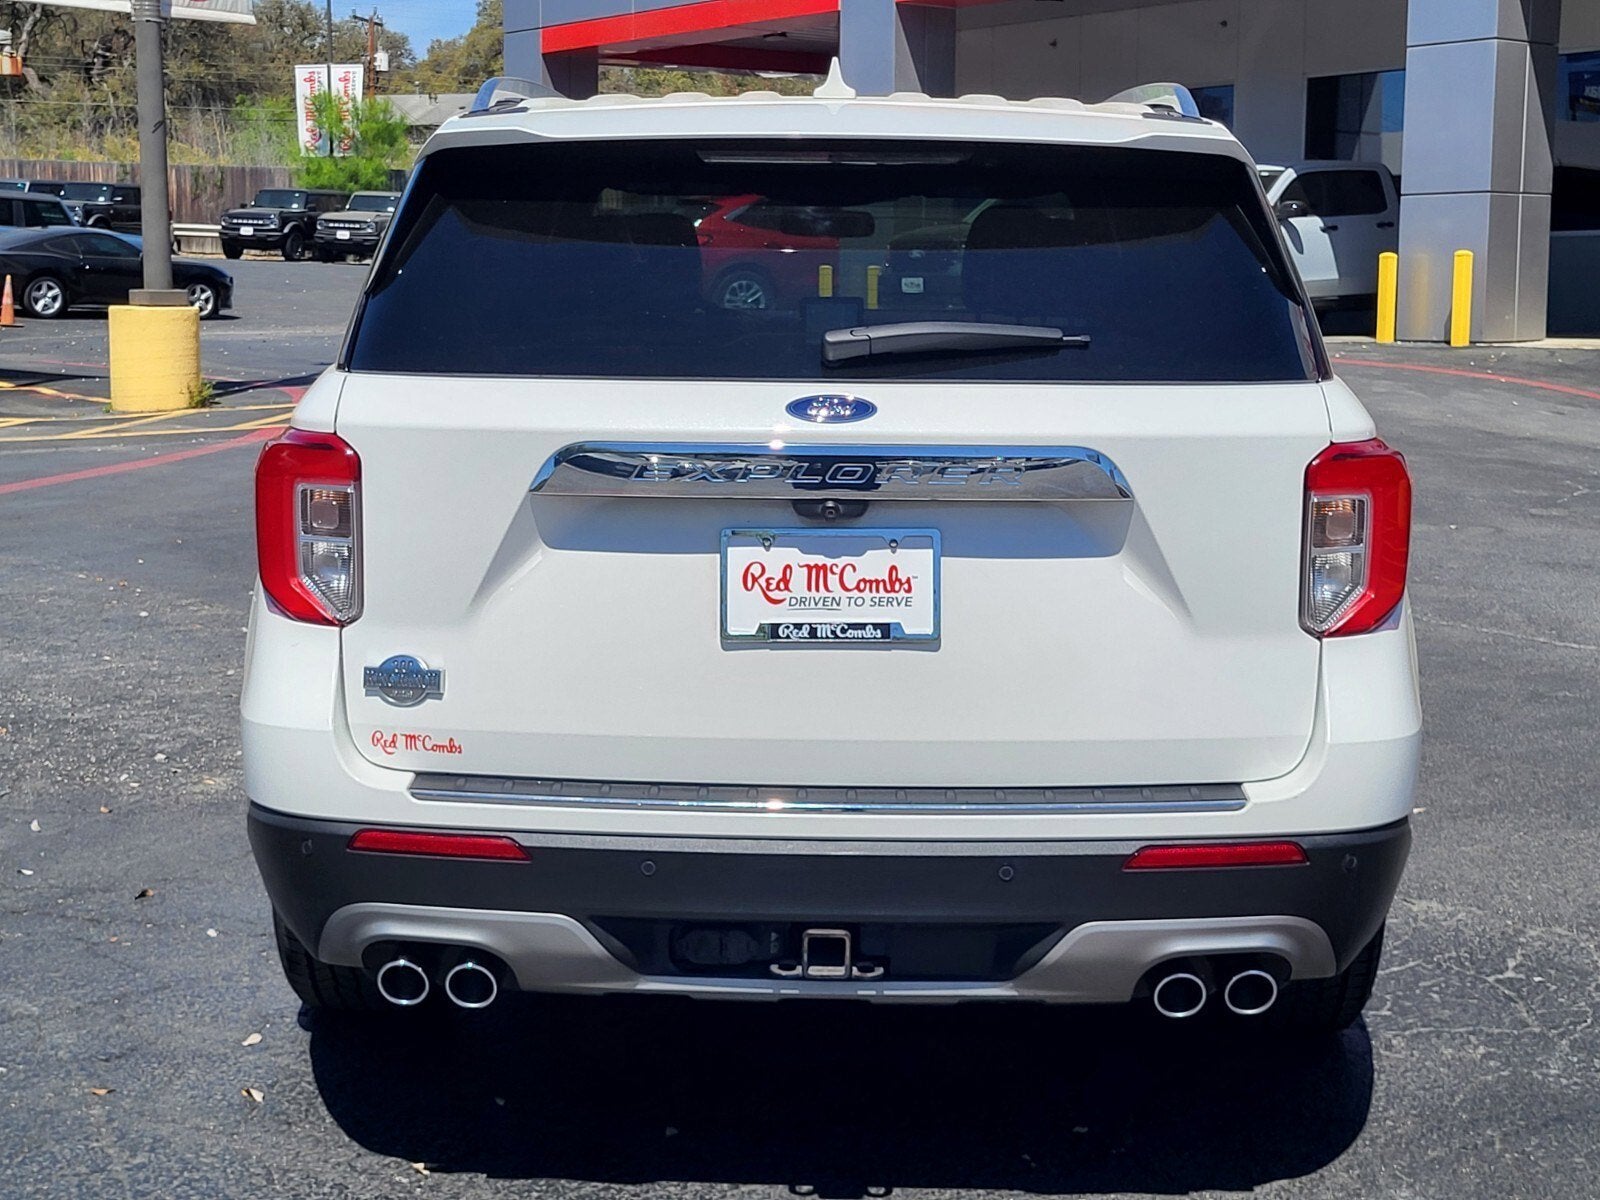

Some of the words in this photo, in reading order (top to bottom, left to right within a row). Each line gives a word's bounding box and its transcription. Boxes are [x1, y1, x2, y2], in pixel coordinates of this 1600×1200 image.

[630, 461, 1027, 486] EXPLORER
[742, 561, 793, 605] Red
[798, 562, 912, 593] McCombs
[788, 596, 841, 607] DRIVEN
[847, 596, 865, 607] TO
[869, 596, 913, 607] SERVE
[778, 623, 809, 640] Red
[812, 623, 882, 639] McCombs
[371, 730, 398, 755] Red
[400, 734, 463, 754] McCombs
